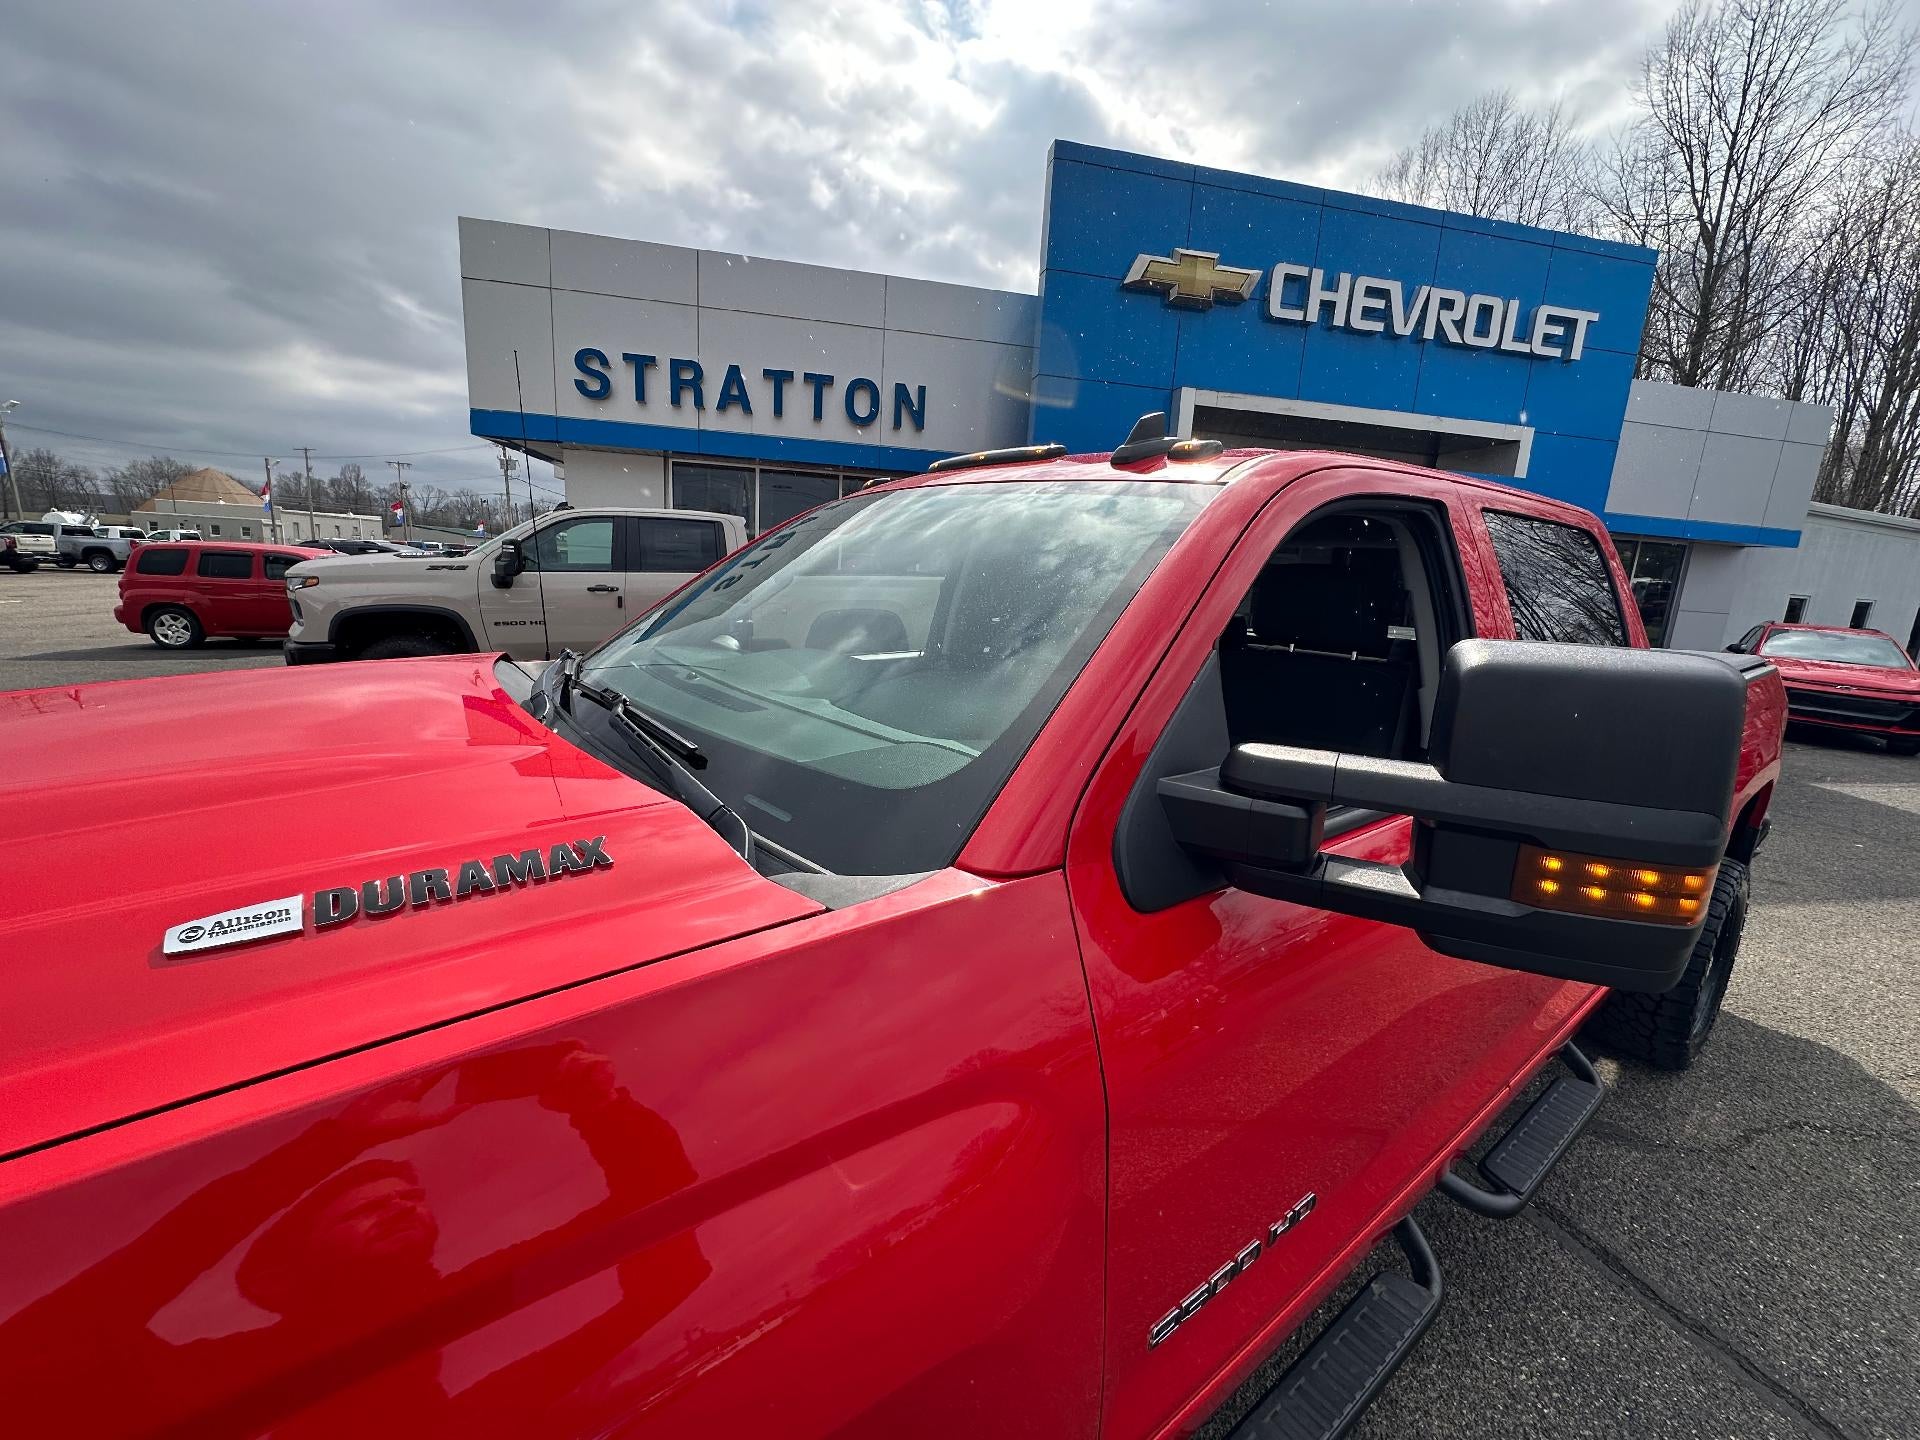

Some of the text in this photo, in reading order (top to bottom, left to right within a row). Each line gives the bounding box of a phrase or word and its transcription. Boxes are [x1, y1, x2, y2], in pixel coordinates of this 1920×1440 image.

[1268, 262, 1600, 361] CHEVROLET
[573, 347, 926, 431] STRATTON
[315, 835, 614, 928] DURAMAX
[207, 916, 292, 939] Transmission
[208, 908, 291, 932] Allison
[1267, 1191, 1317, 1247] HD
